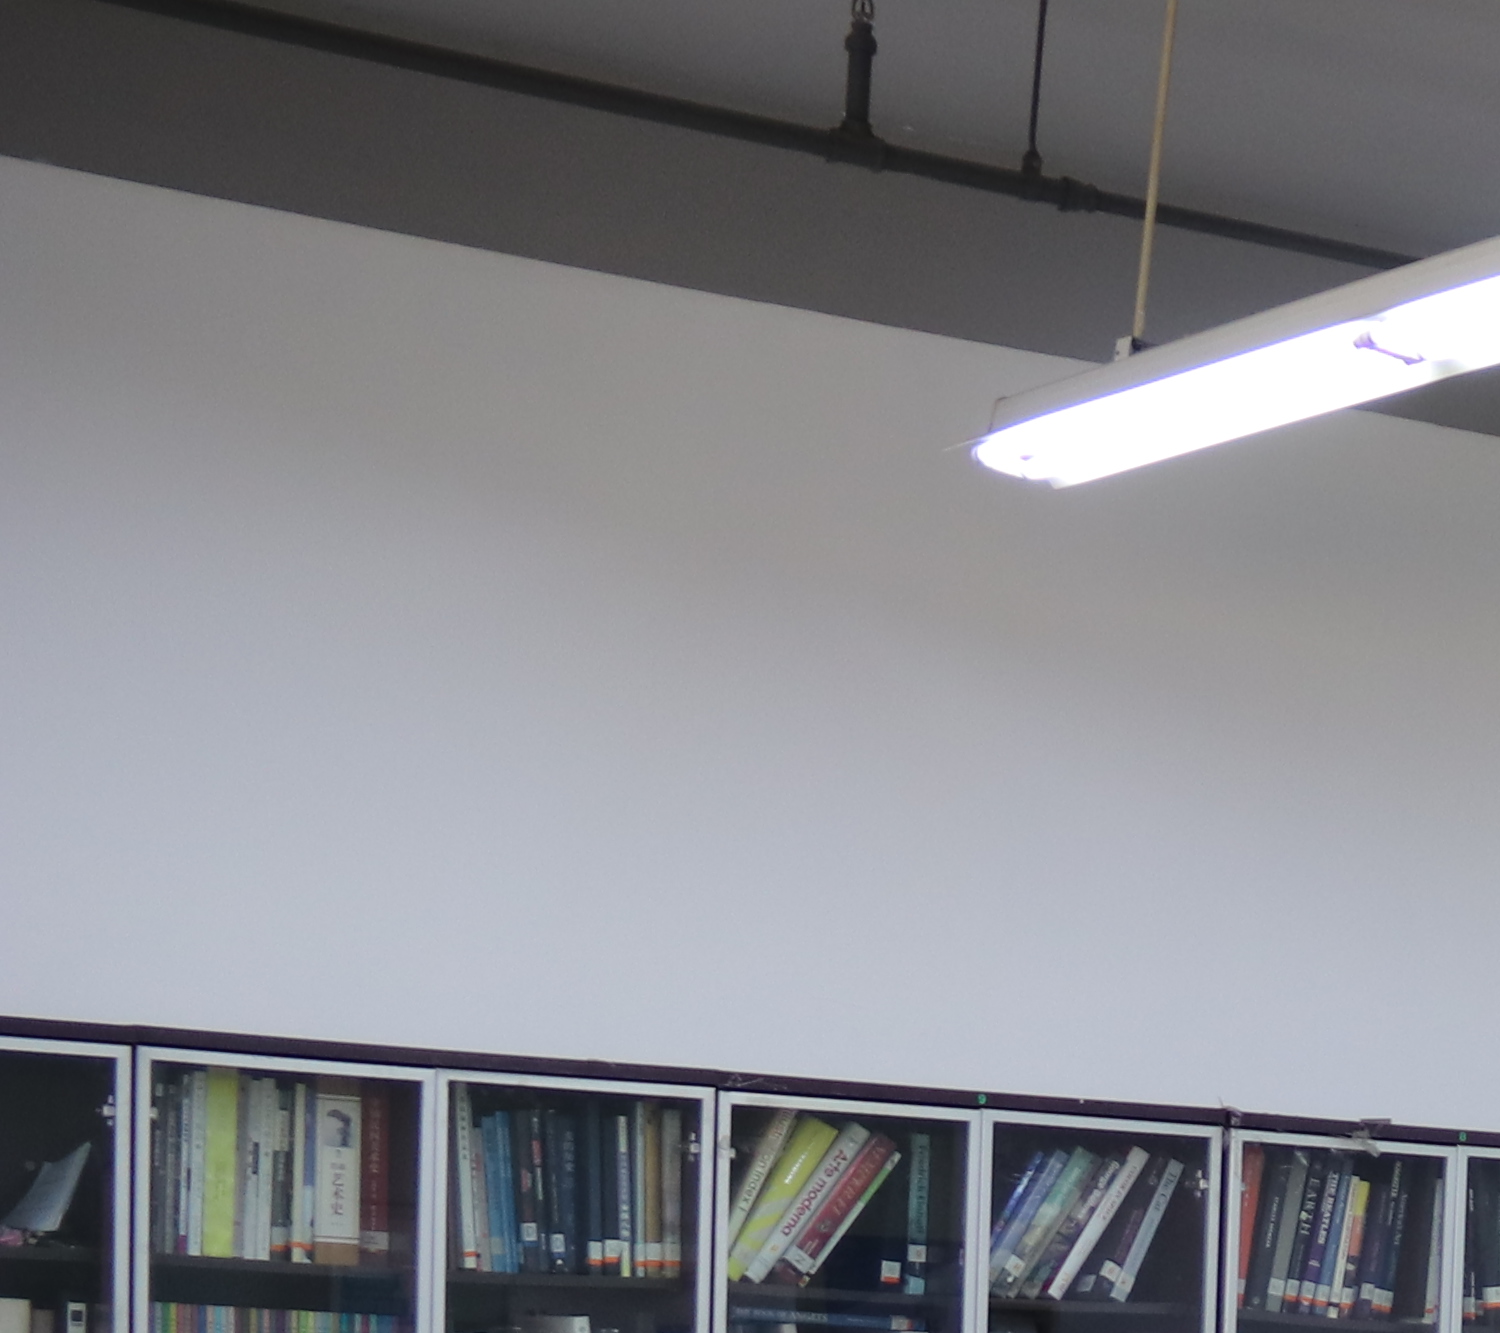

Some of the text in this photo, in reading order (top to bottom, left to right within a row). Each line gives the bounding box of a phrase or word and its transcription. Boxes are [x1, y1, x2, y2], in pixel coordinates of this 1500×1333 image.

[825, 1149, 848, 1177] Arte
[781, 1178, 828, 1237] moderna
[1317, 1196, 1335, 1245] BEATLES
